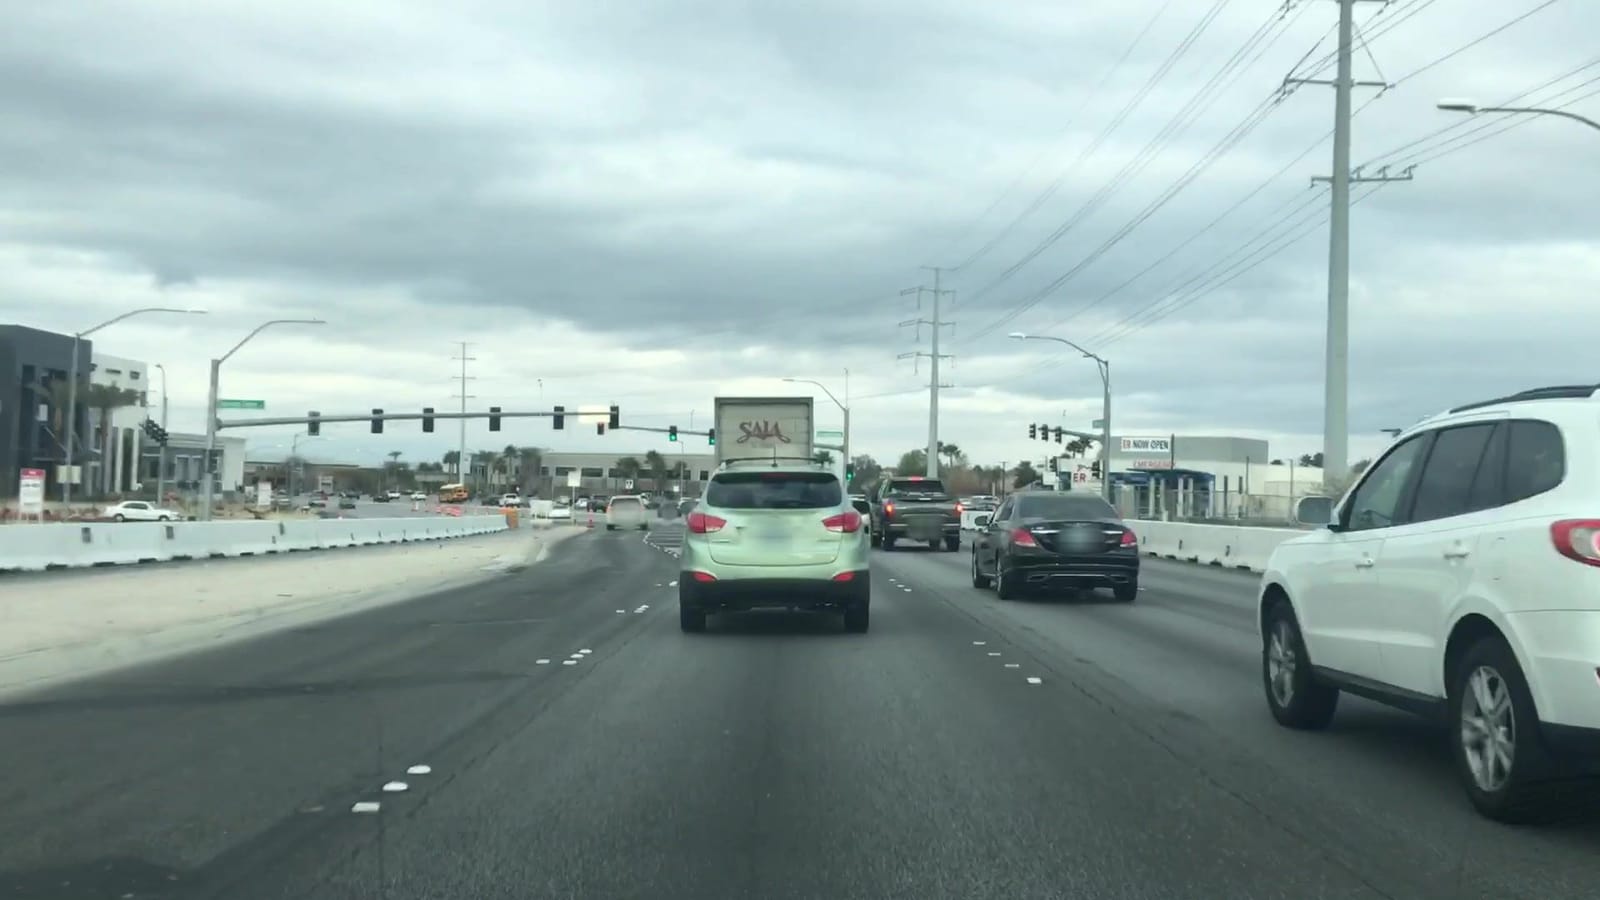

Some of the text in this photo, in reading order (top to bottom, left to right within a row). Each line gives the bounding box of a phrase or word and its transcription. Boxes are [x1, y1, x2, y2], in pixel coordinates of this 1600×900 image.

[1132, 439, 1149, 449] NOW
[1150, 440, 1169, 450] OPEN
[1073, 472, 1086, 483] ER
